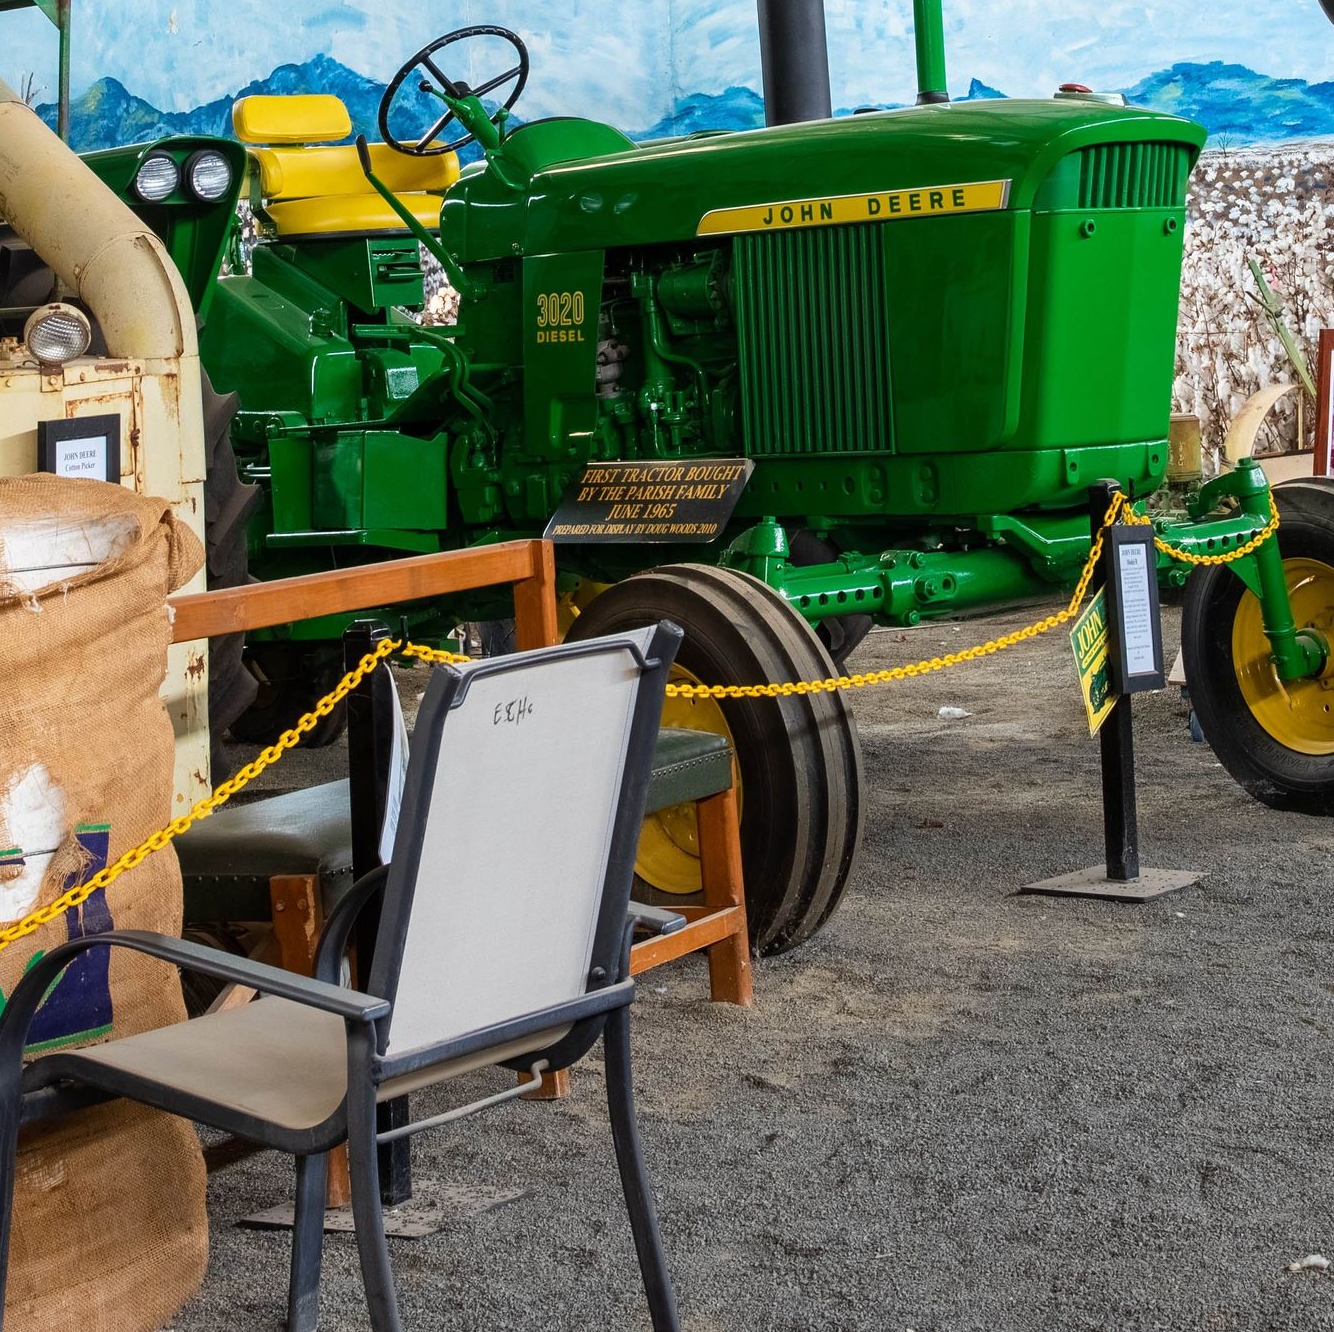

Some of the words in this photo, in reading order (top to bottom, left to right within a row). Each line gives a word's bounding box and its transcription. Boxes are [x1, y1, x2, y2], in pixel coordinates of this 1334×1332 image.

[763, 203, 833, 226] JOHN
[868, 189, 965, 216] DEERE
[537, 291, 584, 327] 3020
[537, 330, 585, 343] DIESEL
[64, 451, 79, 461] JOHN
[79, 449, 97, 460] DEERE
[65, 462, 81, 473] Cotton
[81, 461, 96, 471] Picker
[581, 469, 620, 484] FIRST
[621, 467, 687, 483] TRACTOR
[685, 465, 745, 482] BOUGHT
[577, 487, 599, 501] BY
[598, 486, 626, 501] THE
[625, 485, 676, 500] PARISH
[675, 484, 730, 499] FAMILY
[605, 504, 644, 521] JUNE
[642, 503, 677, 518] 1965
[552, 524, 590, 535] PREPARED
[589, 524, 605, 535] FOR
[604, 523, 635, 535] DISPLAY
[635, 523, 648, 534] BY
[647, 523, 669, 534] DOUG
[669, 523, 699, 534] WOODS
[697, 523, 718, 534] 2010
[1077, 605, 1104, 659] JOHN
